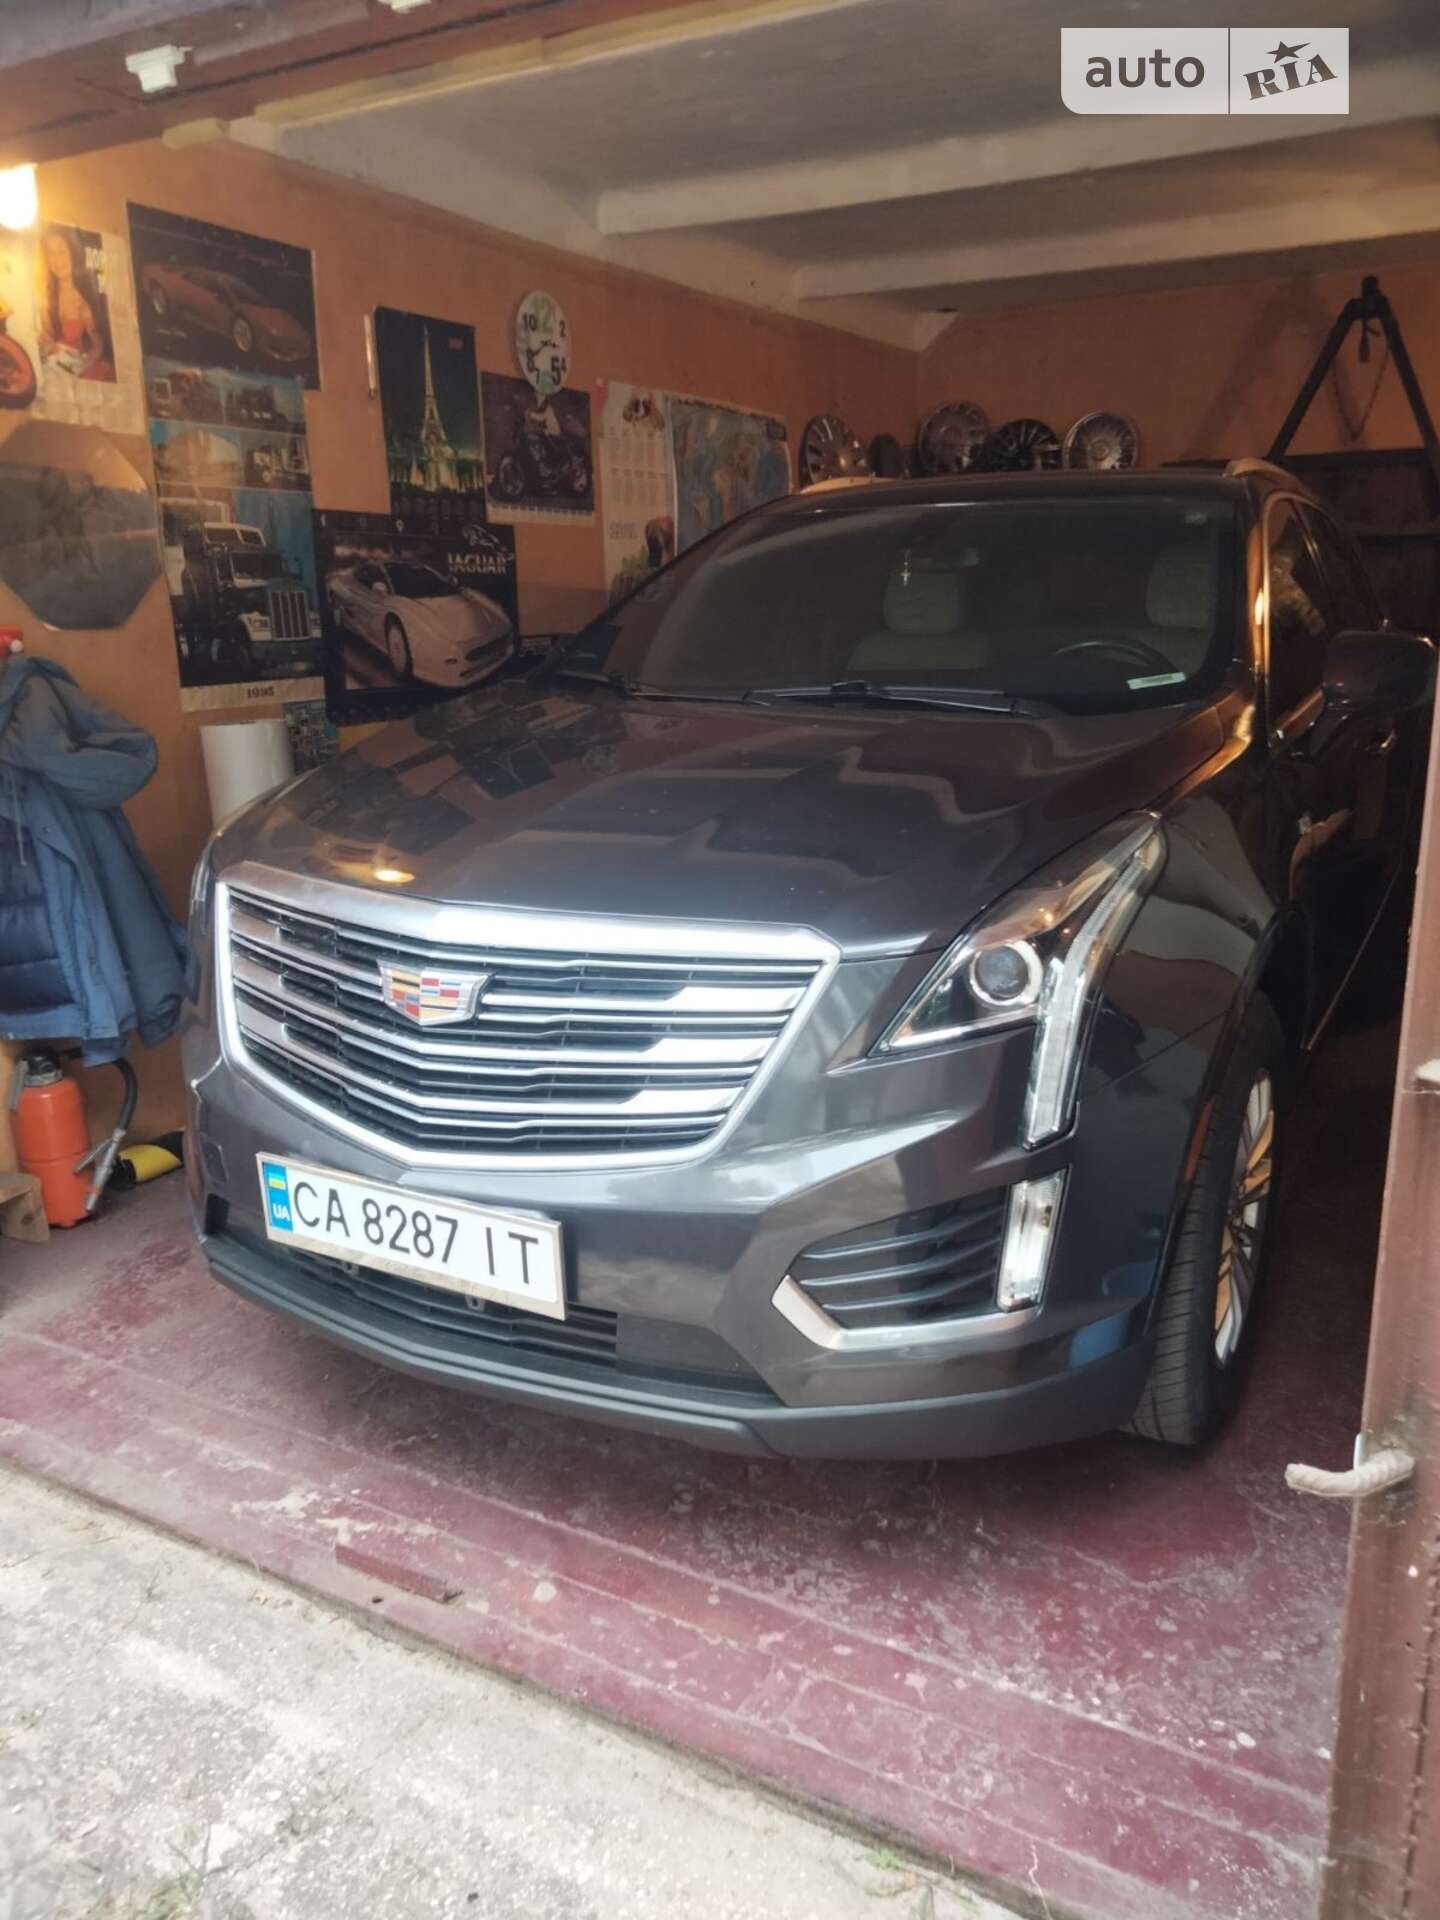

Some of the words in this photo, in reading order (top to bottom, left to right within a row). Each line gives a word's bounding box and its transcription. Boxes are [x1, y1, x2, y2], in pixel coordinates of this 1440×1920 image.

[551, 356, 562, 385] 5
[447, 552, 507, 575] JAGUAR
[272, 1202, 291, 1222] UA
[293, 1181, 351, 1238] CA
[361, 1197, 459, 1264] 8287
[484, 1226, 540, 1285] IT
